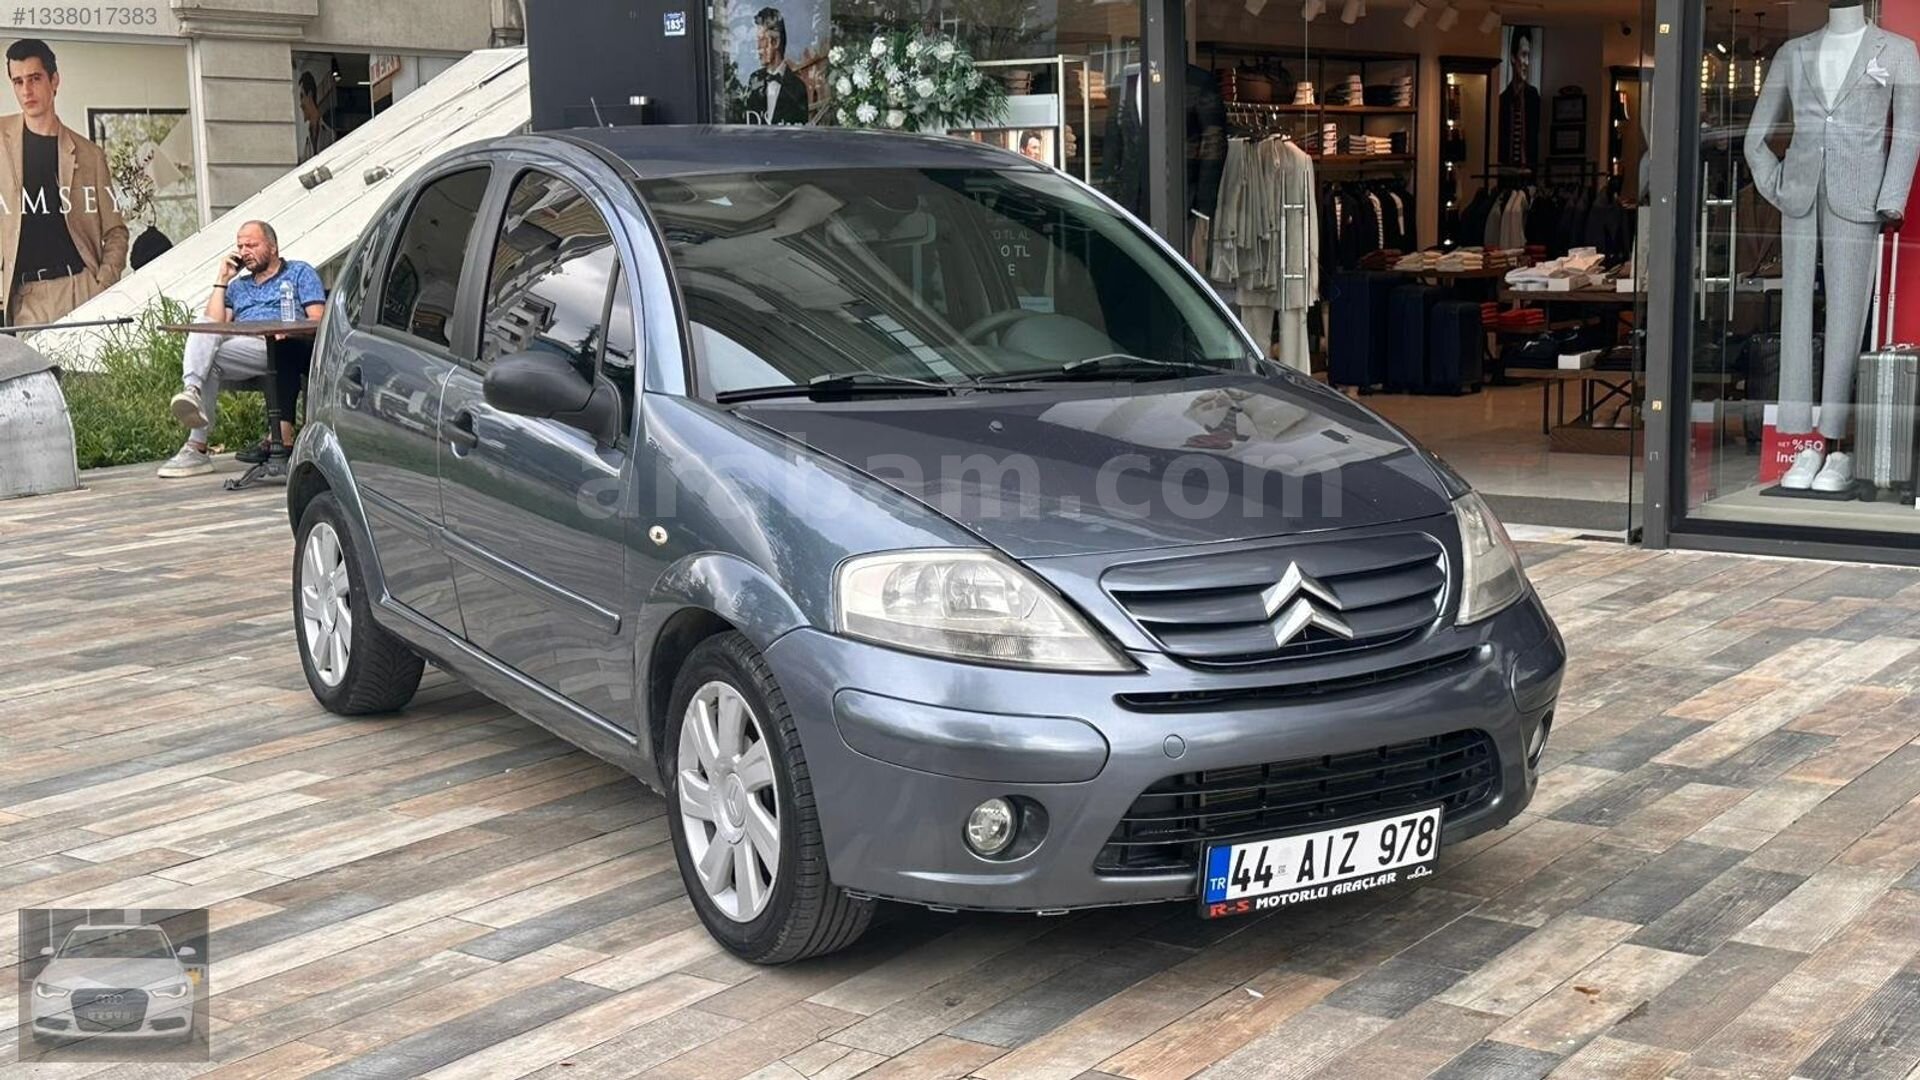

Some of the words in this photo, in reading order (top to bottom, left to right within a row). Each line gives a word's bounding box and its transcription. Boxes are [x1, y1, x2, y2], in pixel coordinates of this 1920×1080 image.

[1013, 245, 1031, 257] TL
[1210, 877, 1226, 891] TR
[1231, 846, 1273, 892] 44
[1296, 830, 1360, 883] AIZ
[1378, 815, 1435, 866] 978
[1210, 900, 1250, 917] R-S
[1255, 886, 1329, 910] MOTORLU
[1331, 872, 1397, 896] ARAÇLAR
